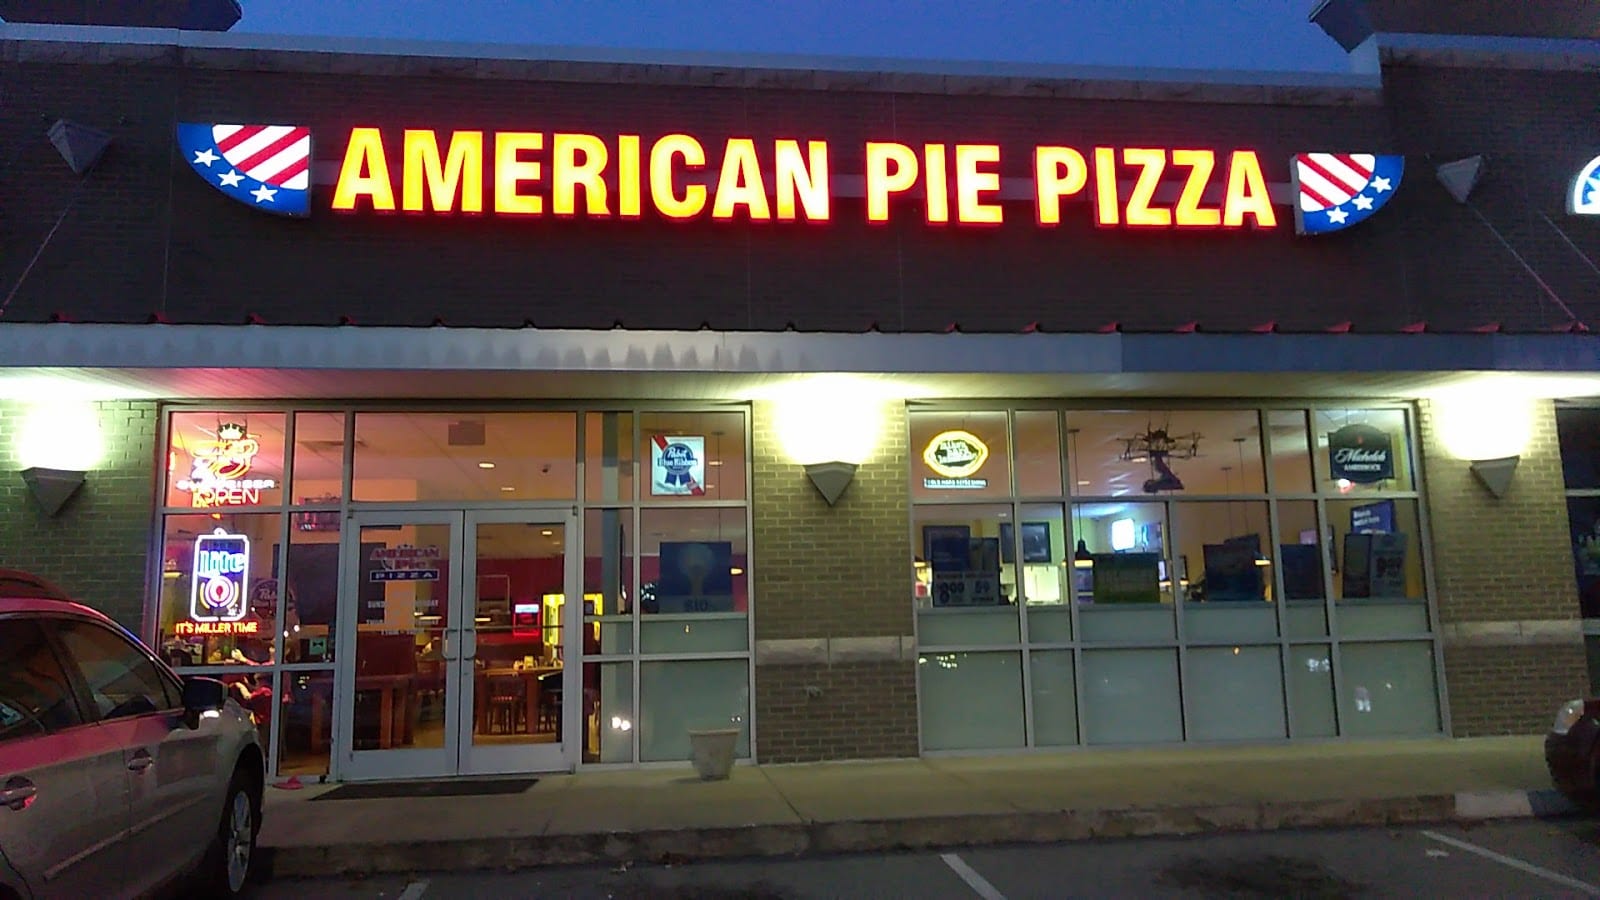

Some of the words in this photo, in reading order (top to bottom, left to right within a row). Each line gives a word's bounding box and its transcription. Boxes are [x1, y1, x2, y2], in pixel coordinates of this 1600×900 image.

[332, 126, 830, 221] AMERICAN
[865, 141, 1004, 223] PIE
[1034, 145, 1277, 227] PIZZA
[374, 572, 434, 580] PIZZA
[175, 621, 194, 634] IT'S
[194, 622, 232, 634] MILLER
[232, 621, 258, 634] TIME
